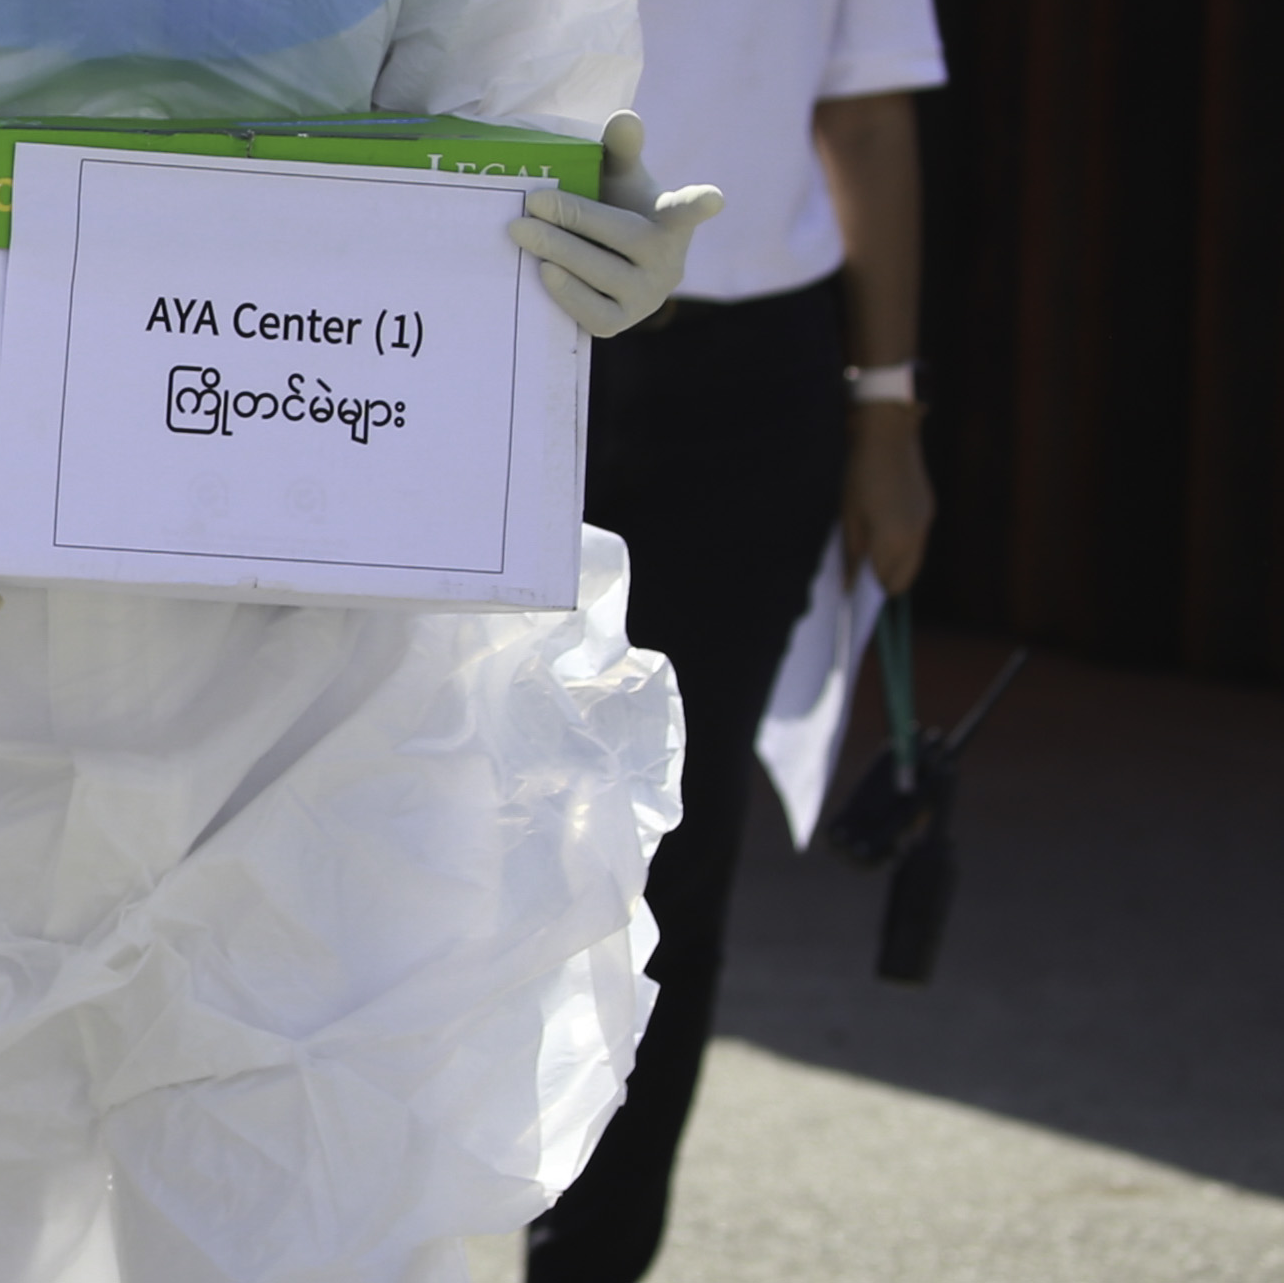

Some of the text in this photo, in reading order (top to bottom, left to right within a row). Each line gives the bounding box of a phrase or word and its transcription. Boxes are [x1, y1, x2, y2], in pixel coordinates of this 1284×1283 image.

[145, 296, 424, 358] AYA Center (1)
[165, 364, 407, 446] ကြိုတင်မဲများ
